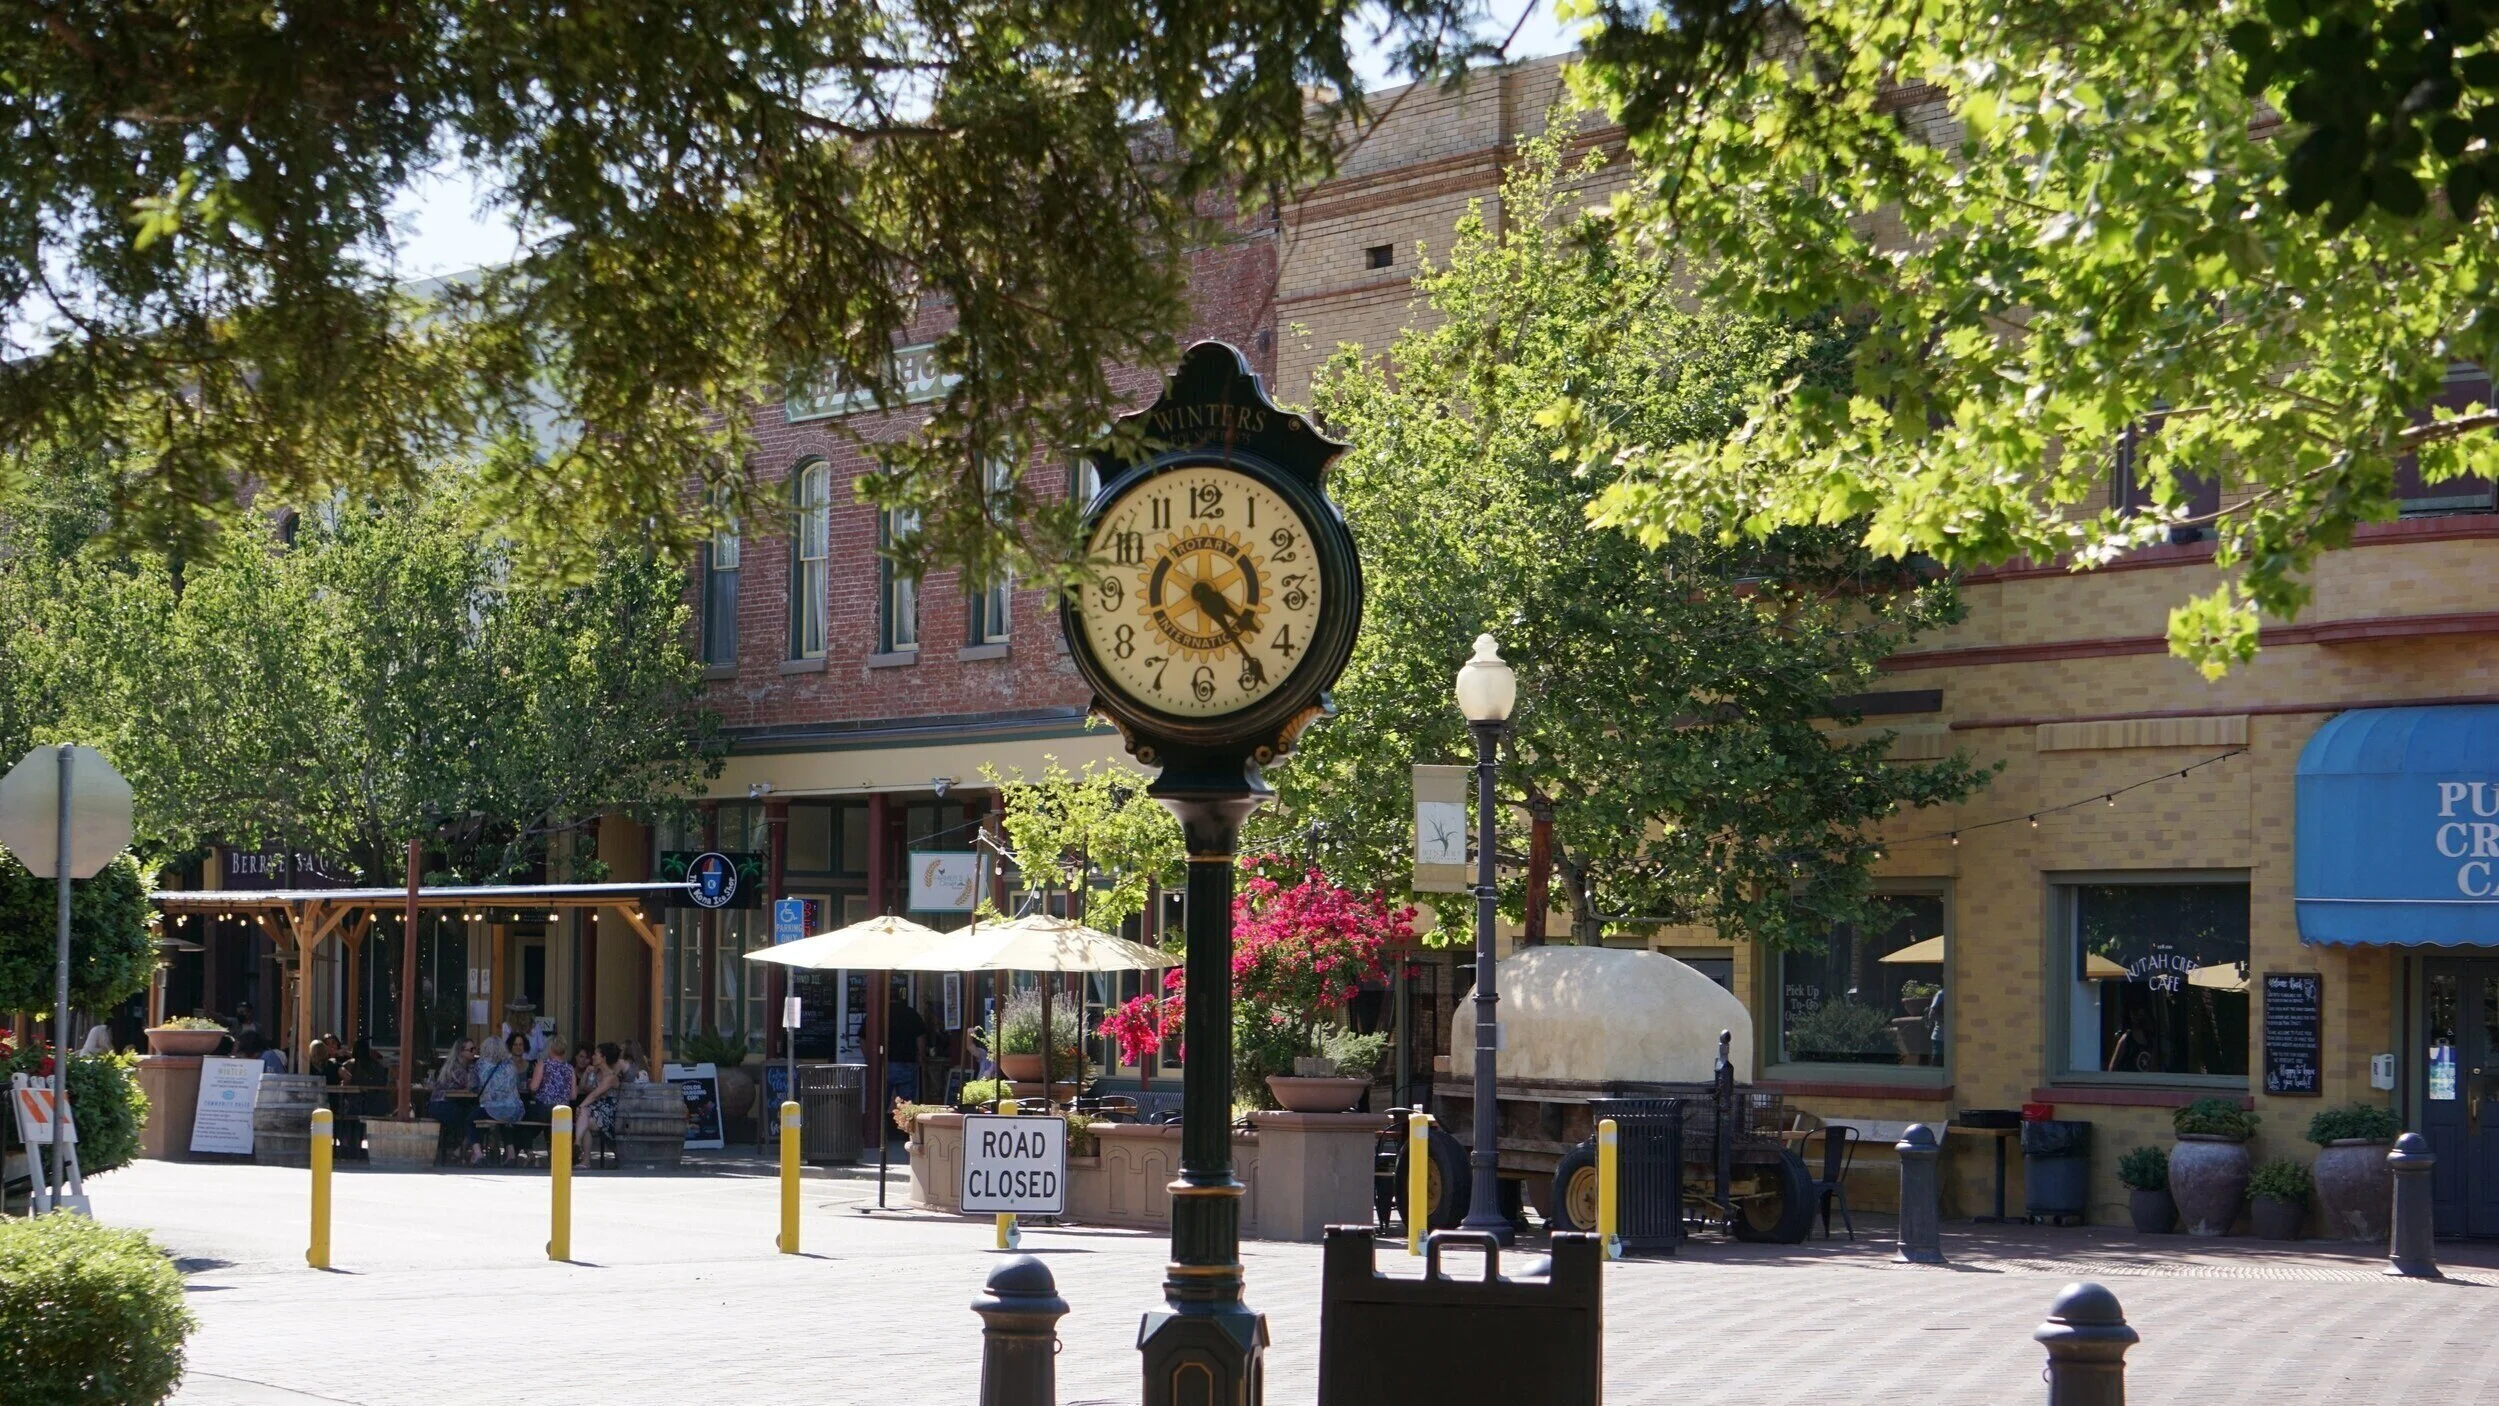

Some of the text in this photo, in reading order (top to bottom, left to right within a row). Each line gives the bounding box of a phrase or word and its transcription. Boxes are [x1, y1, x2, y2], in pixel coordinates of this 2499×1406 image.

[1153, 403, 1267, 433] WINTERS
[1169, 430, 1230, 443] FOUNDE
[1152, 497, 1171, 530] 11
[1189, 484, 1225, 519] 12
[1247, 495, 1256, 529] 1
[1115, 530, 1144, 565] 10
[1176, 538, 1234, 554] ROTARY
[1269, 527, 1297, 563] 2
[1100, 575, 1125, 612] 9
[1281, 573, 1309, 611] 3
[1114, 623, 1136, 659] 8
[1270, 623, 1296, 657] 4
[1144, 656, 1169, 691] 7
[1191, 665, 1216, 702] 6
[232, 852, 314, 874] BERRYESA
[2457, 861, 2499, 897] C
[776, 923, 803, 933] PARKING
[781, 933, 798, 943] ONLY
[2124, 954, 2203, 983] PUTAH CREE
[2149, 975, 2180, 992] CAFE
[1785, 984, 1820, 999] Pick Up
[1790, 998, 1819, 1010] To-Go
[982, 1130, 1046, 1158] ROAD
[969, 1169, 1057, 1198] CLOSED
